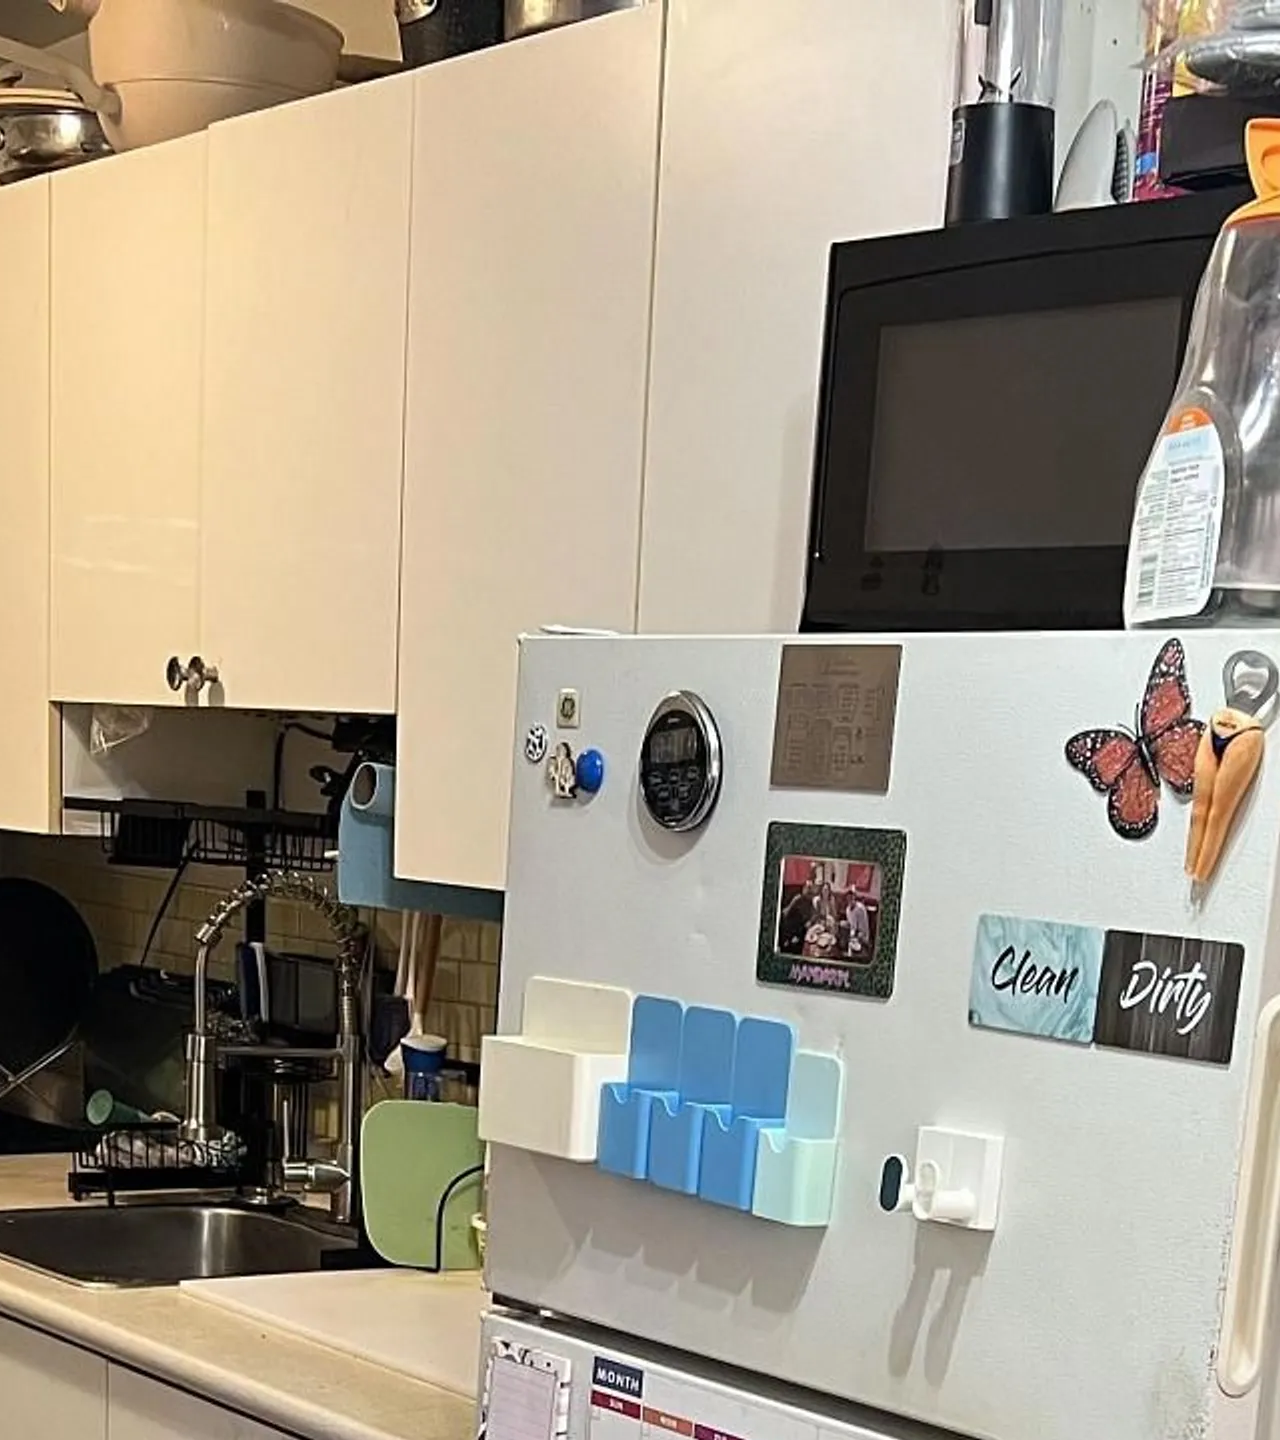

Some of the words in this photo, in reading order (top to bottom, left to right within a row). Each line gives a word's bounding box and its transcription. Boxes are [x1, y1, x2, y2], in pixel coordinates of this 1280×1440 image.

[991, 945, 1079, 1003] Clean
[1120, 961, 1212, 1035] Dirty
[595, 1367, 640, 1392] MONTH
